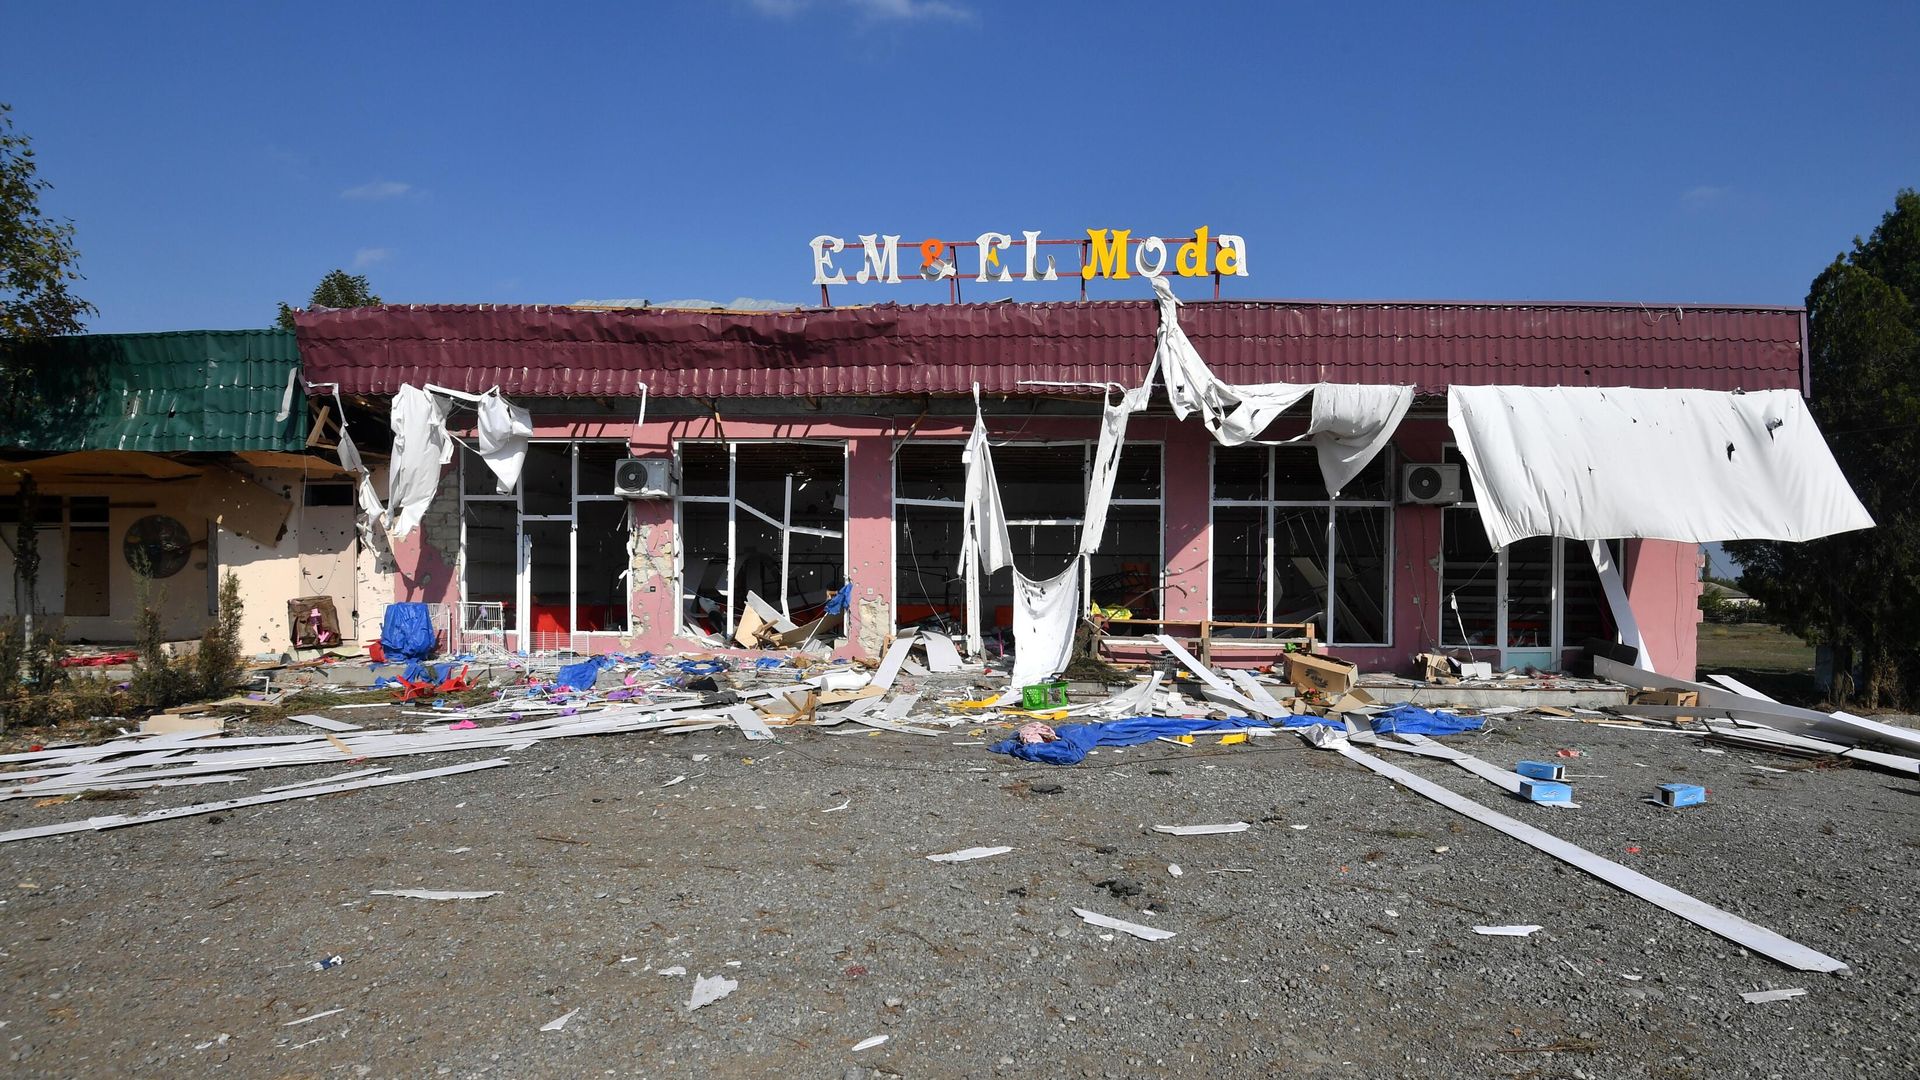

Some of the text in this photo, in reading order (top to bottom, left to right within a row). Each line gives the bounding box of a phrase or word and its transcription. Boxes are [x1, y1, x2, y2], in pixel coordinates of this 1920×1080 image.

[809, 224, 1250, 285] EM & EL Moda
